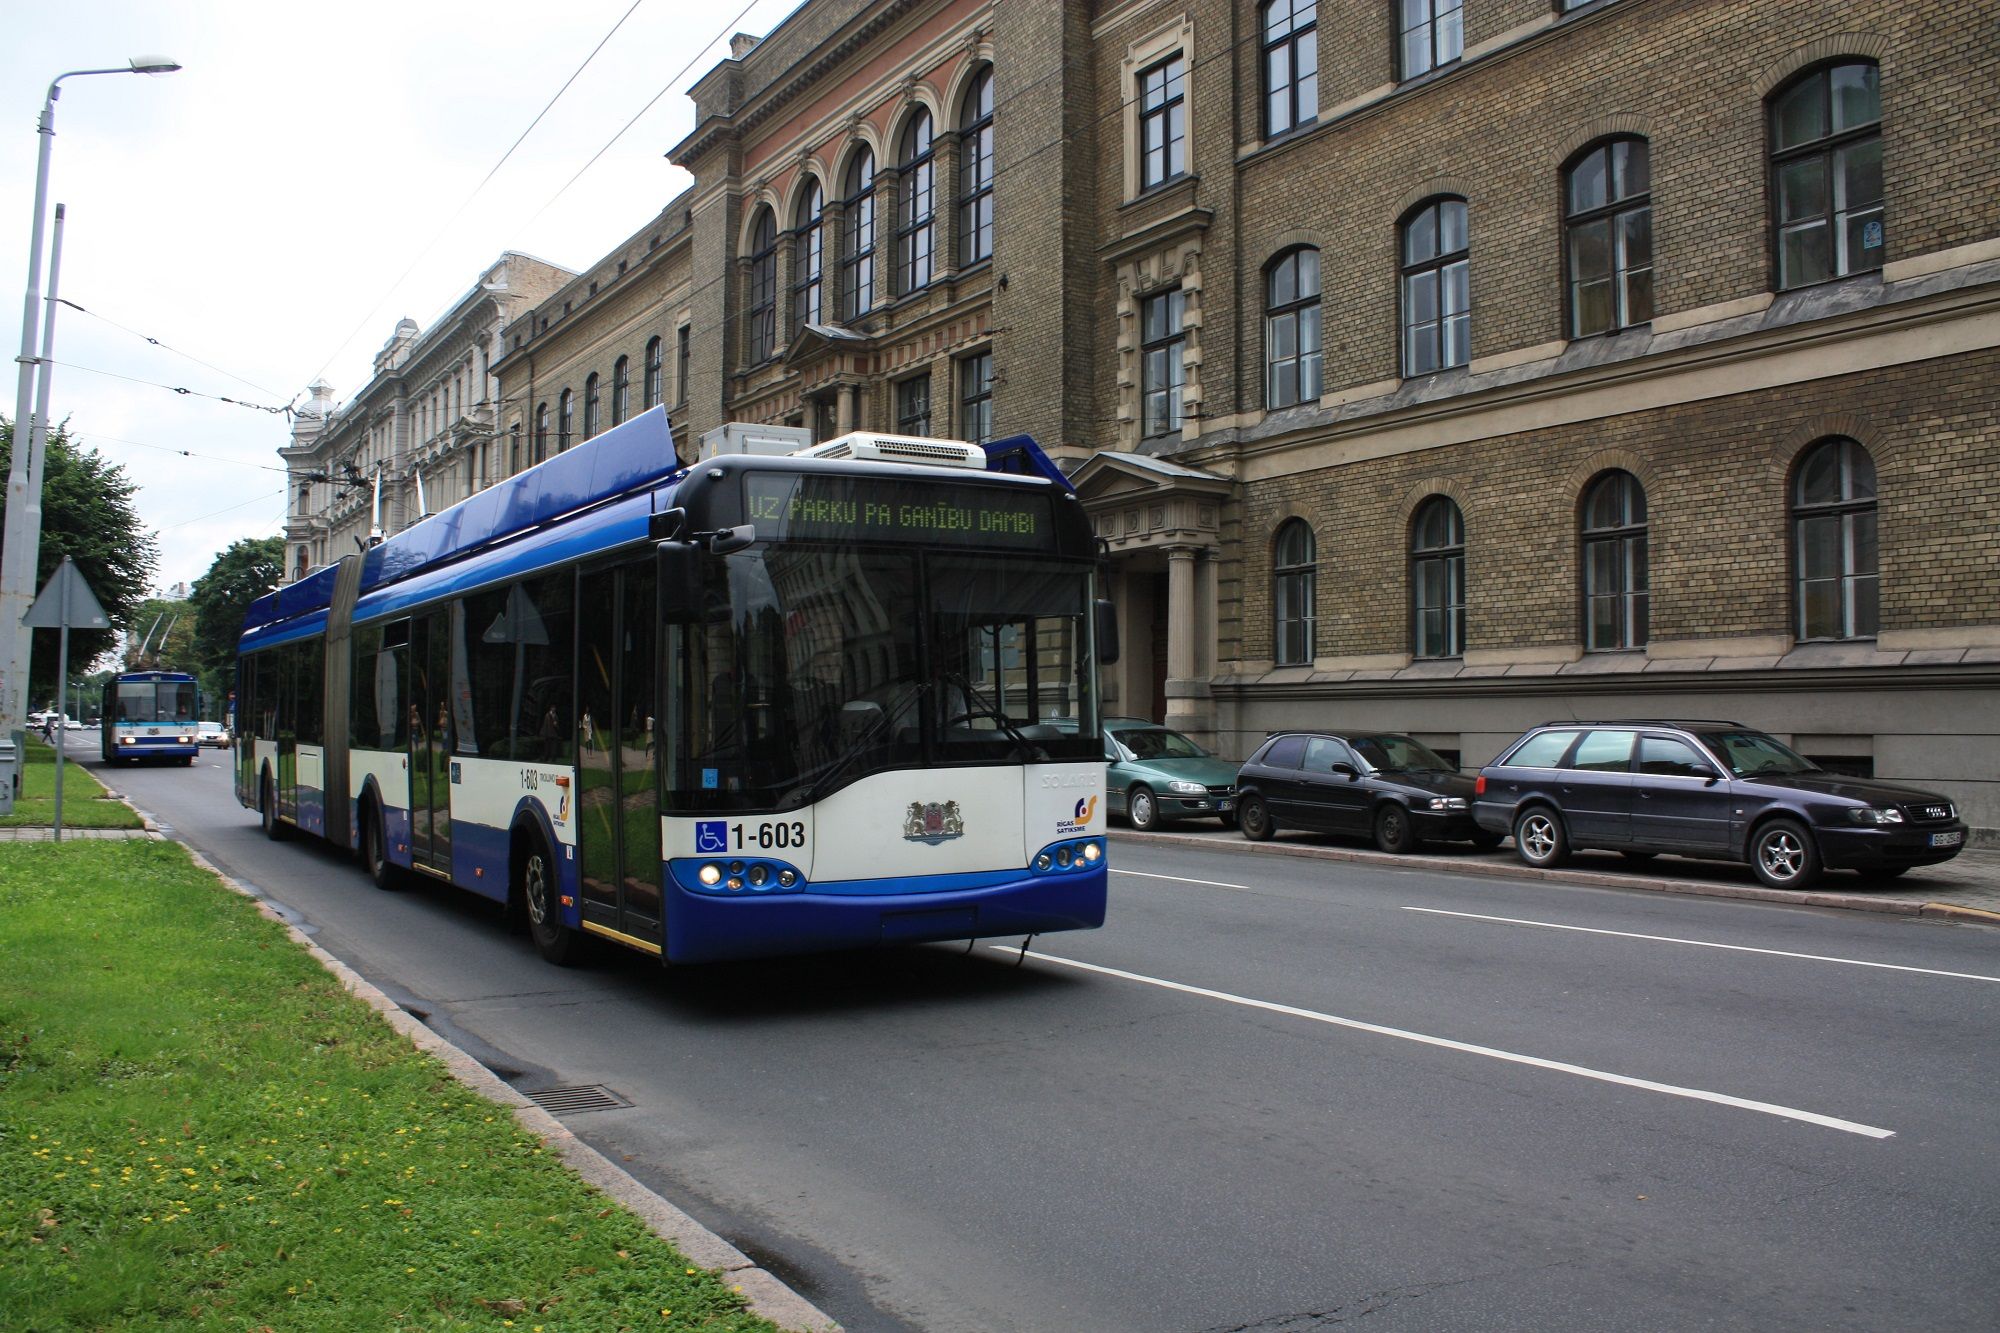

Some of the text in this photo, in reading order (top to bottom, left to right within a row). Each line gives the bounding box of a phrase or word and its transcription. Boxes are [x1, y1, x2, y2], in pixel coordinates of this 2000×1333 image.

[750, 495, 779, 519] UZ
[789, 498, 856, 523] PARKU
[865, 503, 890, 525] PA
[980, 510, 1034, 533] DAMBI
[520, 768, 538, 790] 1-603
[731, 821, 805, 850] 1-603
